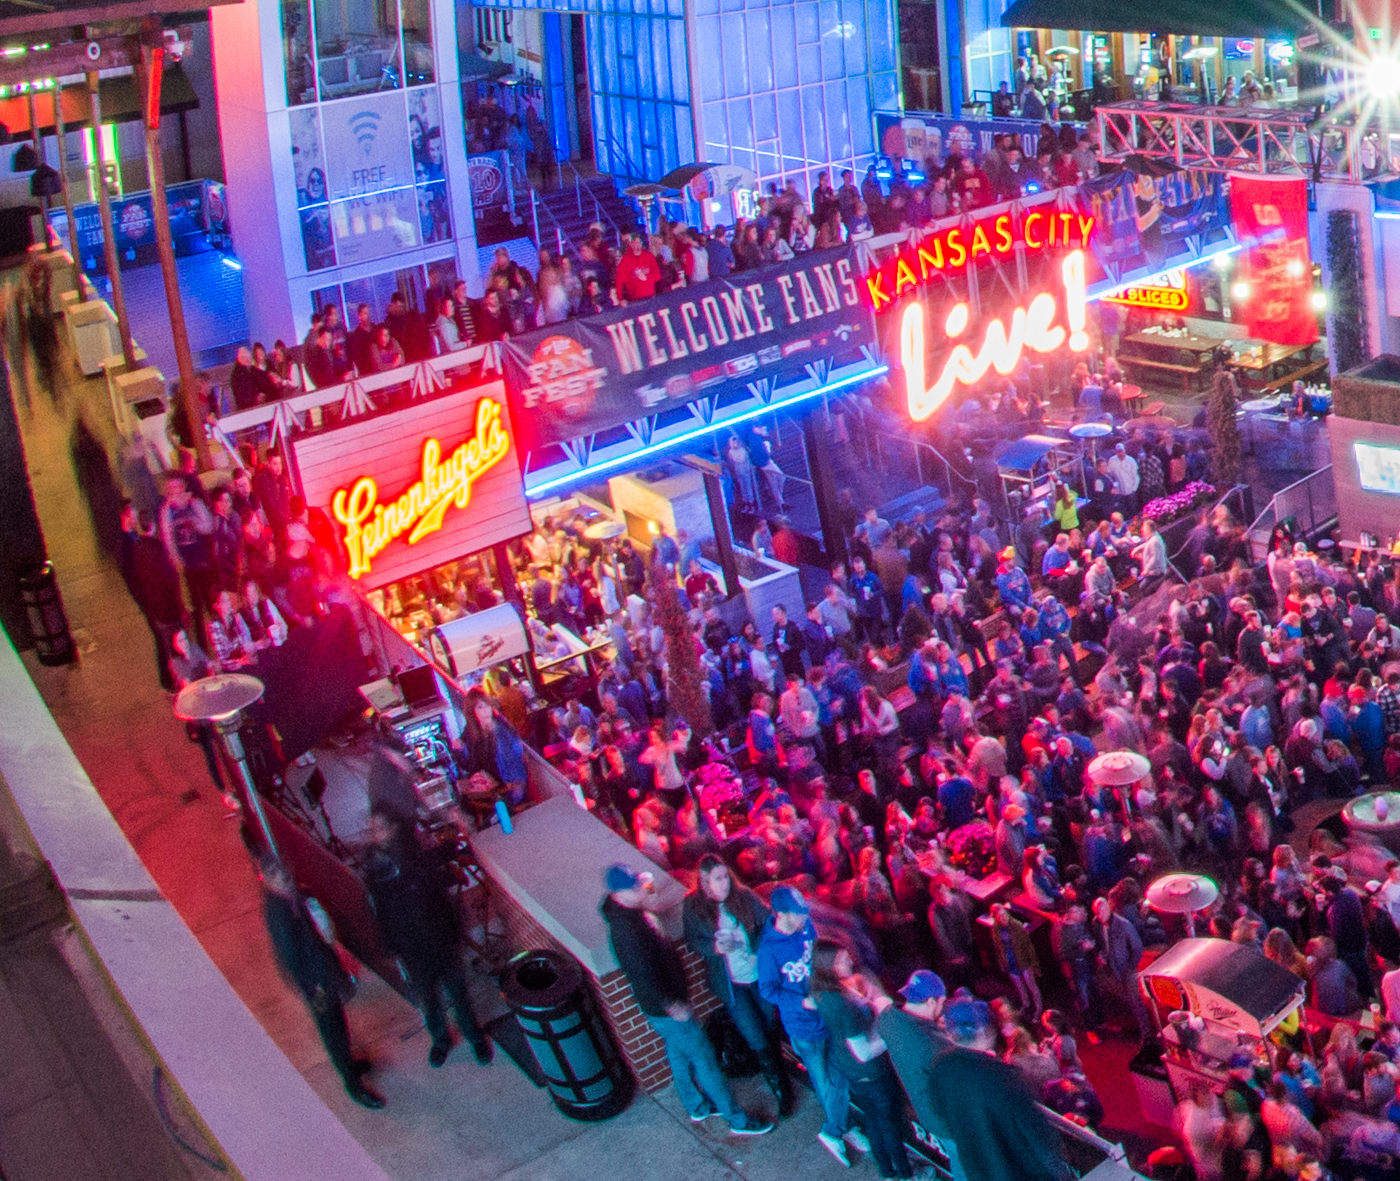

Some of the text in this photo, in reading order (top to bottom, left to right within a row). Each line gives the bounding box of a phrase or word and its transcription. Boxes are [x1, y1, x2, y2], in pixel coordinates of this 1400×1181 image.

[353, 165, 386, 187] FREE
[866, 212, 1097, 311] KANSAS CITY
[605, 283, 776, 375] WELCOME
[777, 257, 860, 325] FANS
[1127, 289, 1181, 306] SLICES
[528, 348, 595, 385] FAN
[901, 249, 1090, 424] Live!
[522, 367, 608, 409] FEST
[333, 397, 509, 580] Leinenkugel's
